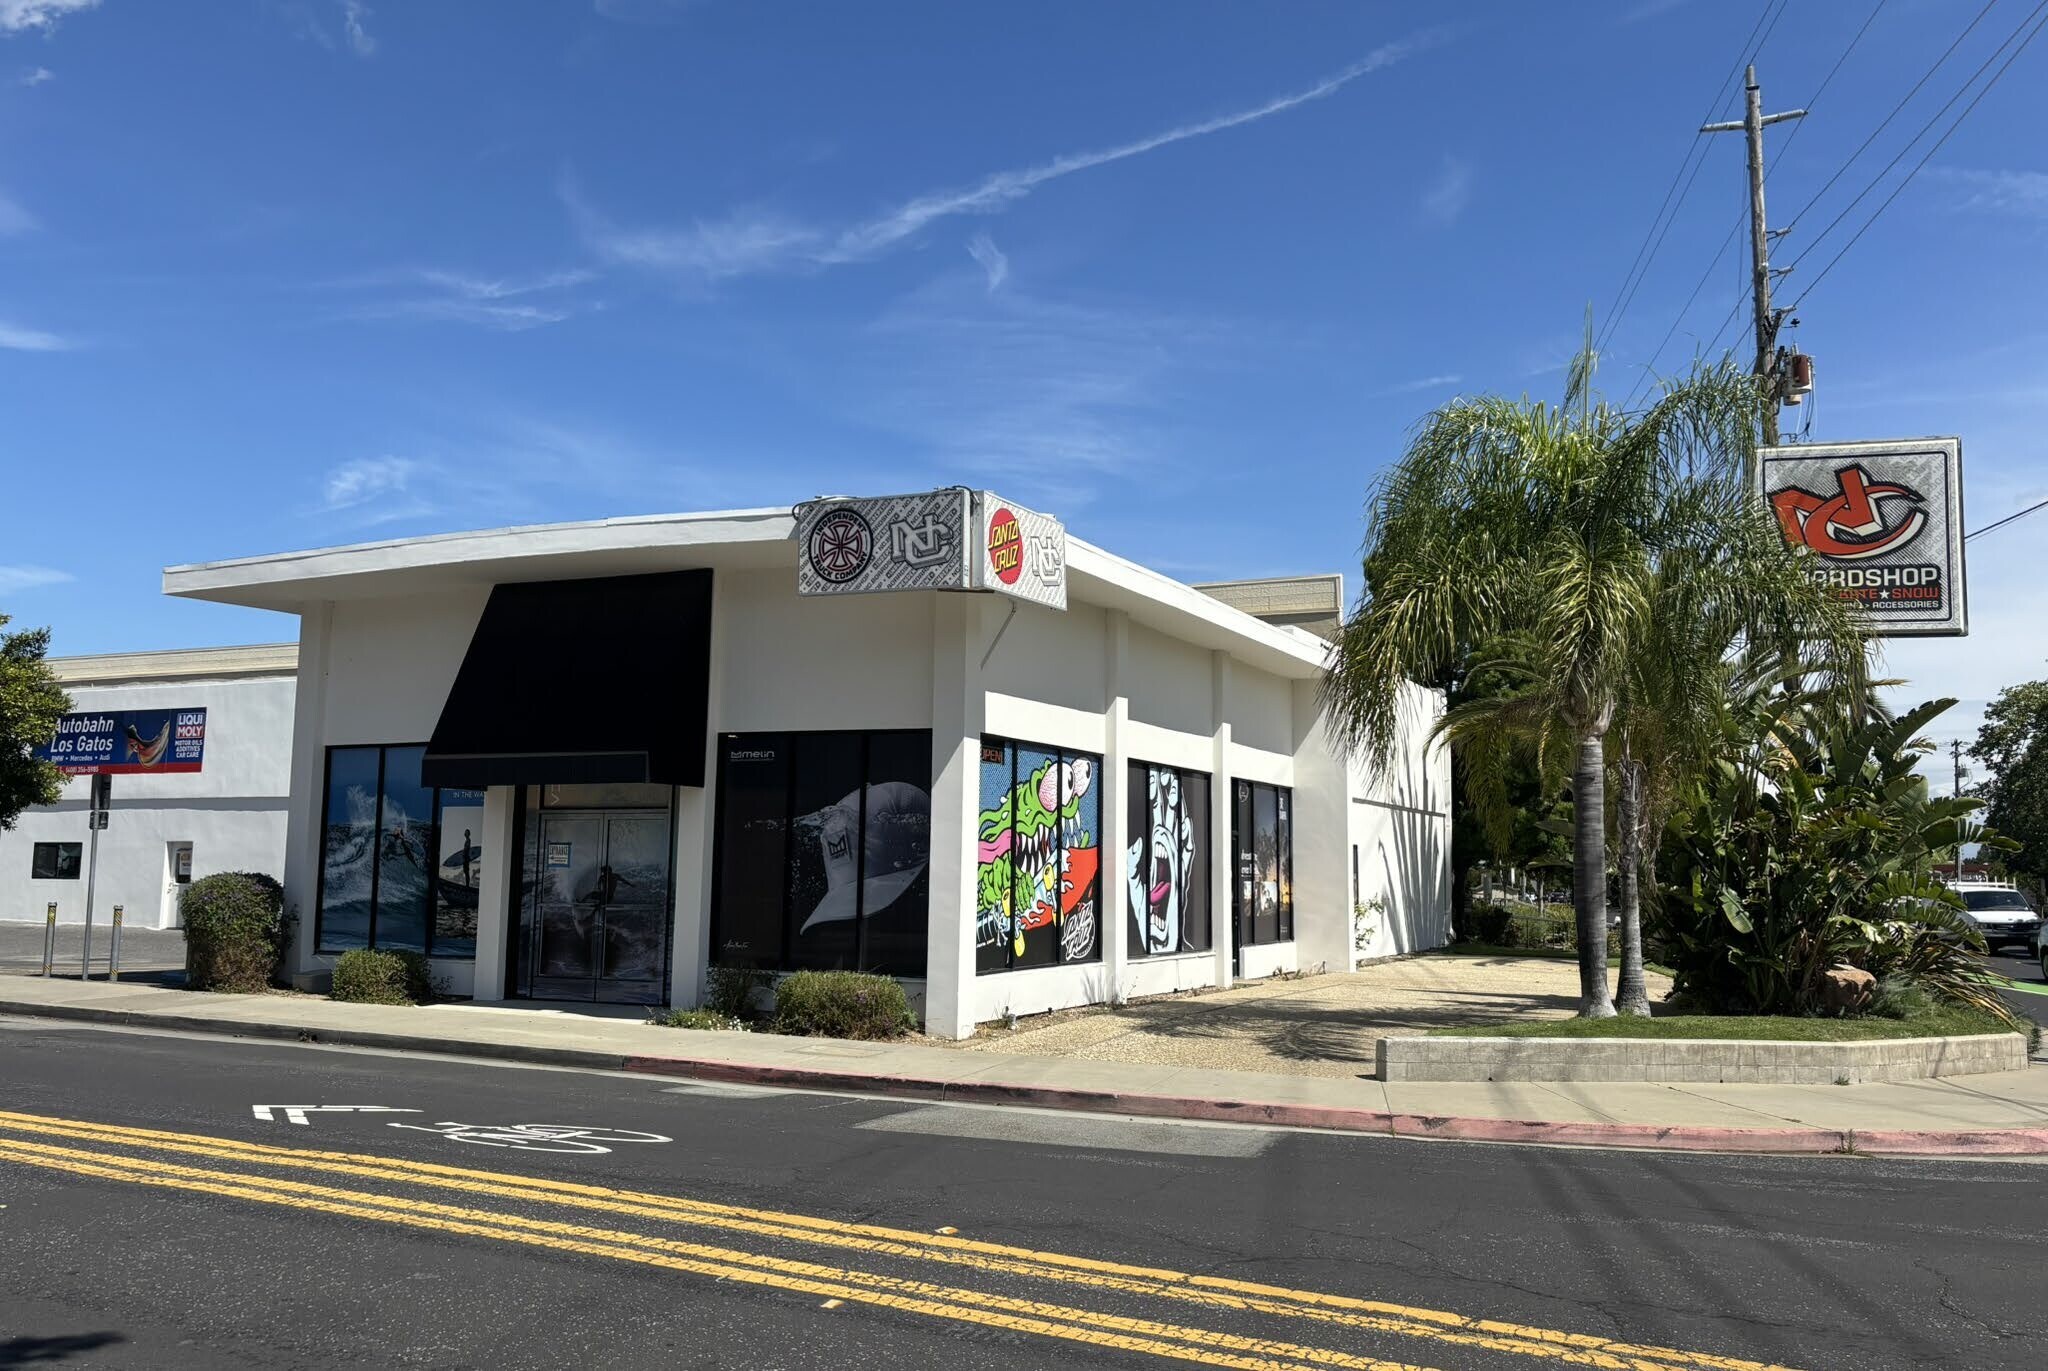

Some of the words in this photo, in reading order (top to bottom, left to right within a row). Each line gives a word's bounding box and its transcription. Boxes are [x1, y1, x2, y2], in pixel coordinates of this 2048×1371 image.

[815, 512, 867, 536] INDEPENDENT
[988, 519, 1019, 550] SANTA
[813, 554, 832, 578] TRUCK
[835, 552, 868, 579] COMPANY
[994, 545, 1019, 574] CRUZ
[1892, 587, 1939, 599] SNOW
[1872, 600, 1939, 609] ACCESSORIES
[55, 716, 114, 734] Autobahn
[179, 714, 203, 725] LIQUI
[177, 726, 203, 737] MOLY
[50, 736, 73, 753] Los
[77, 735, 113, 752] Gatos
[70, 754, 93, 762] Mercedes
